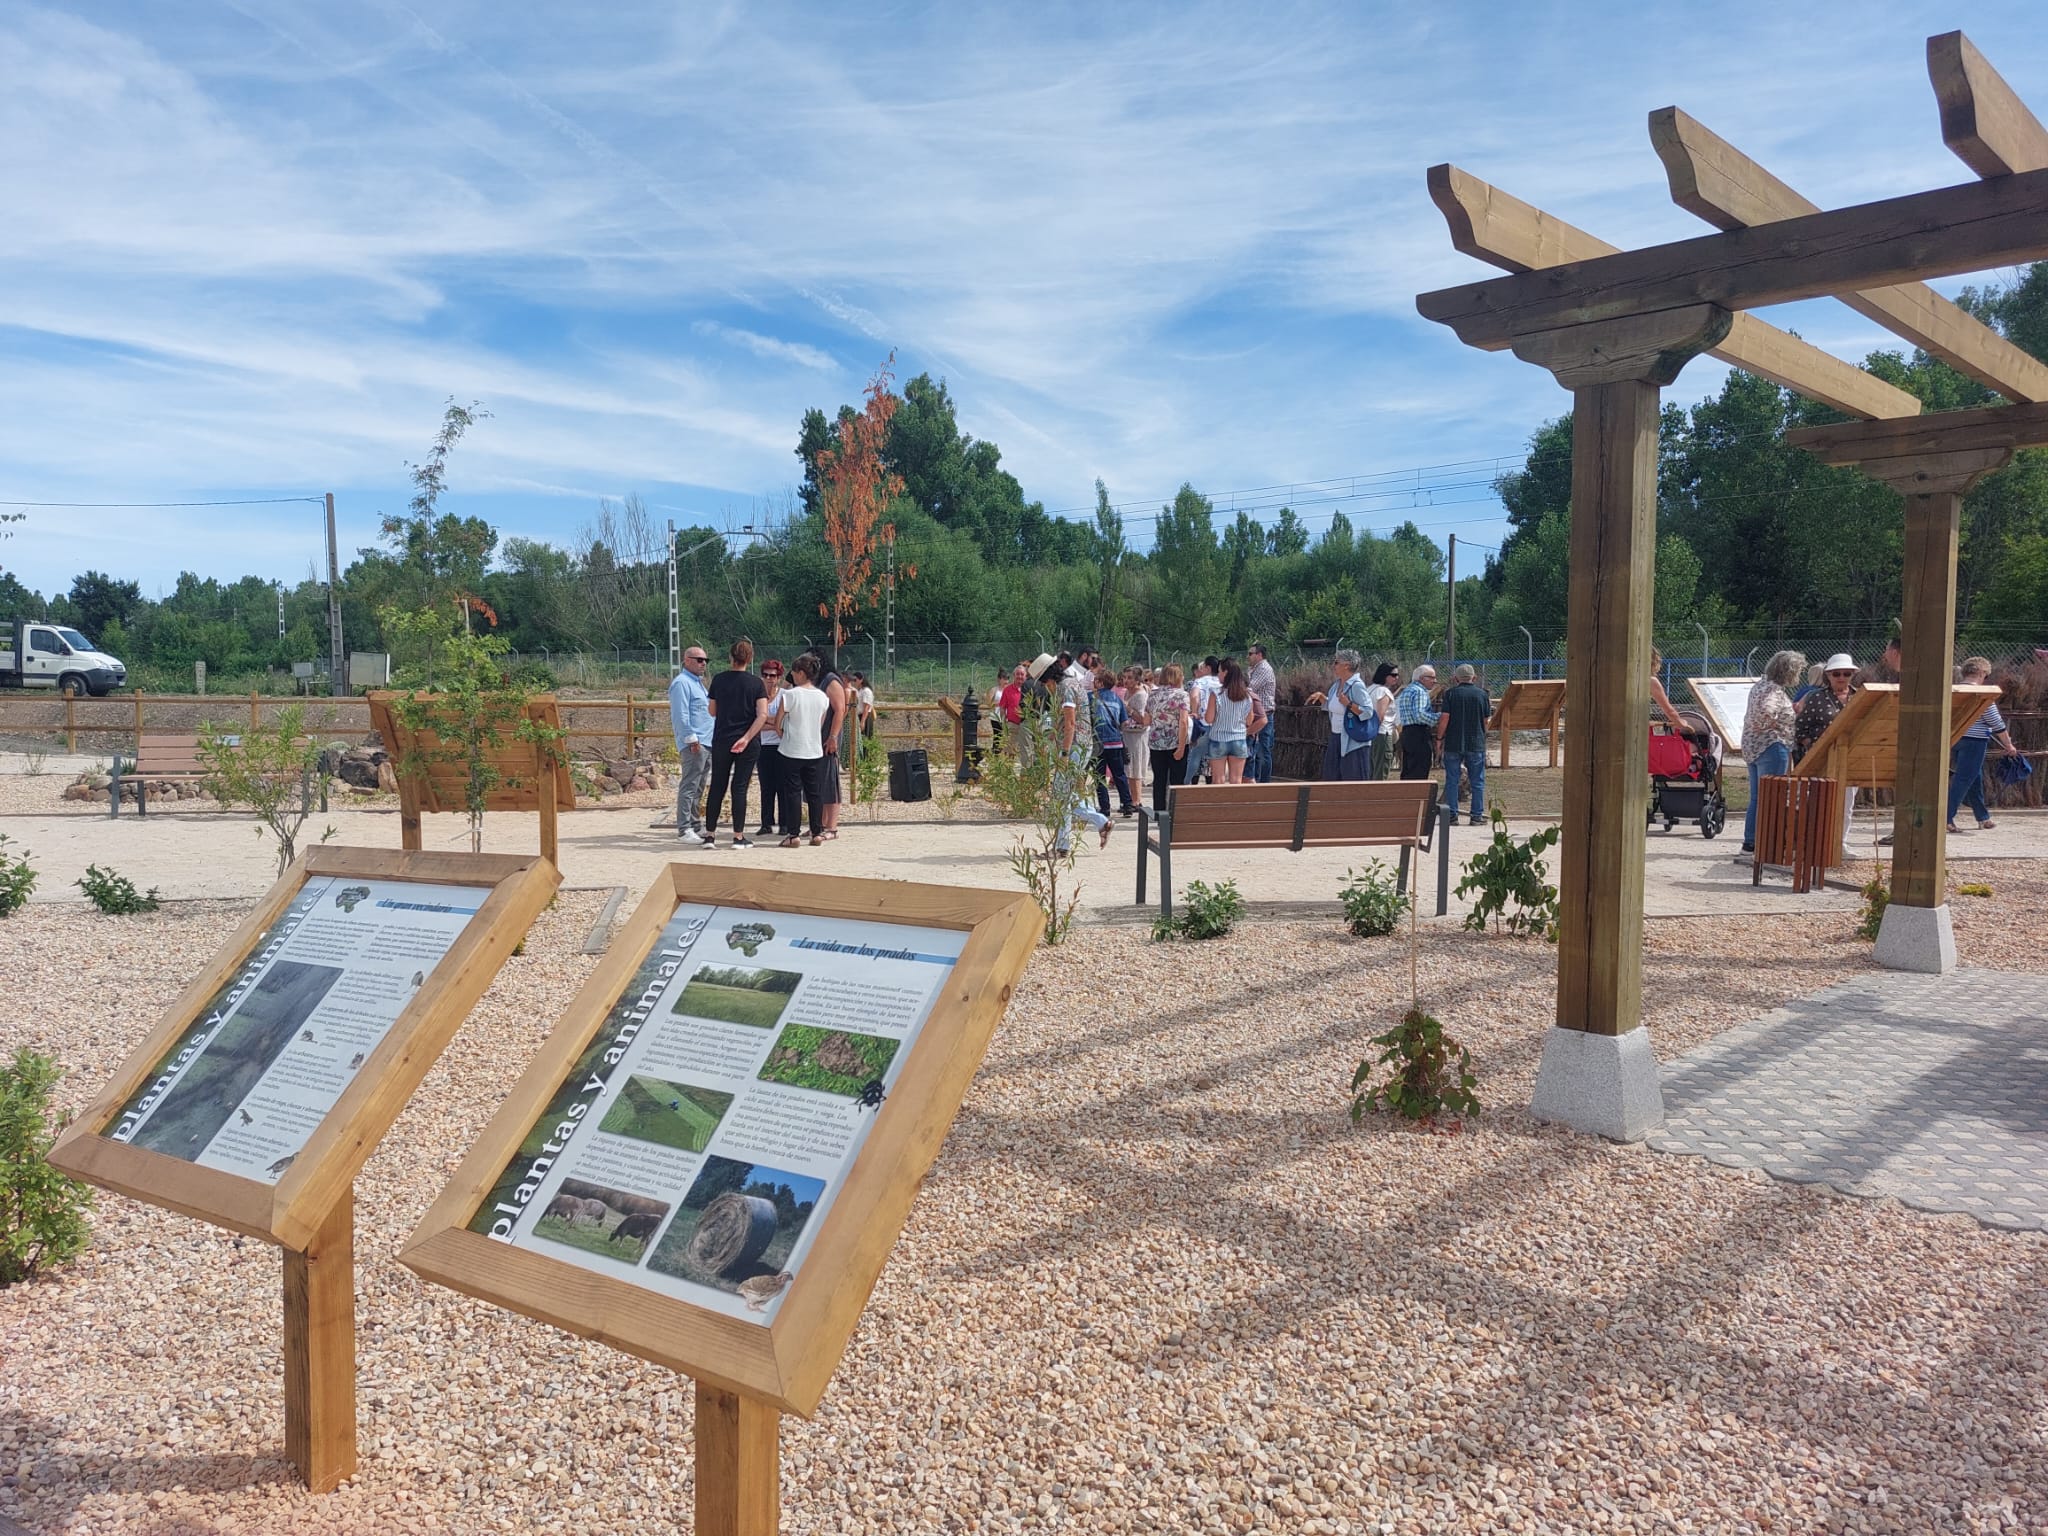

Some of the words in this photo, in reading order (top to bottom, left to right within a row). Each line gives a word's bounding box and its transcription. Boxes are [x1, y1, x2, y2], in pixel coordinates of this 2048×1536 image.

[112, 1034, 206, 1141] plantas
[204, 1010, 223, 1028] y
[226, 887, 326, 1004] animales
[798, 937, 815, 949] La
[815, 939, 841, 952] vida
[842, 944, 858, 953] en
[859, 943, 875, 956] los
[873, 947, 918, 961] prados
[487, 1103, 588, 1244] plantas
[581, 1072, 608, 1097] y
[603, 918, 706, 1065] animales
